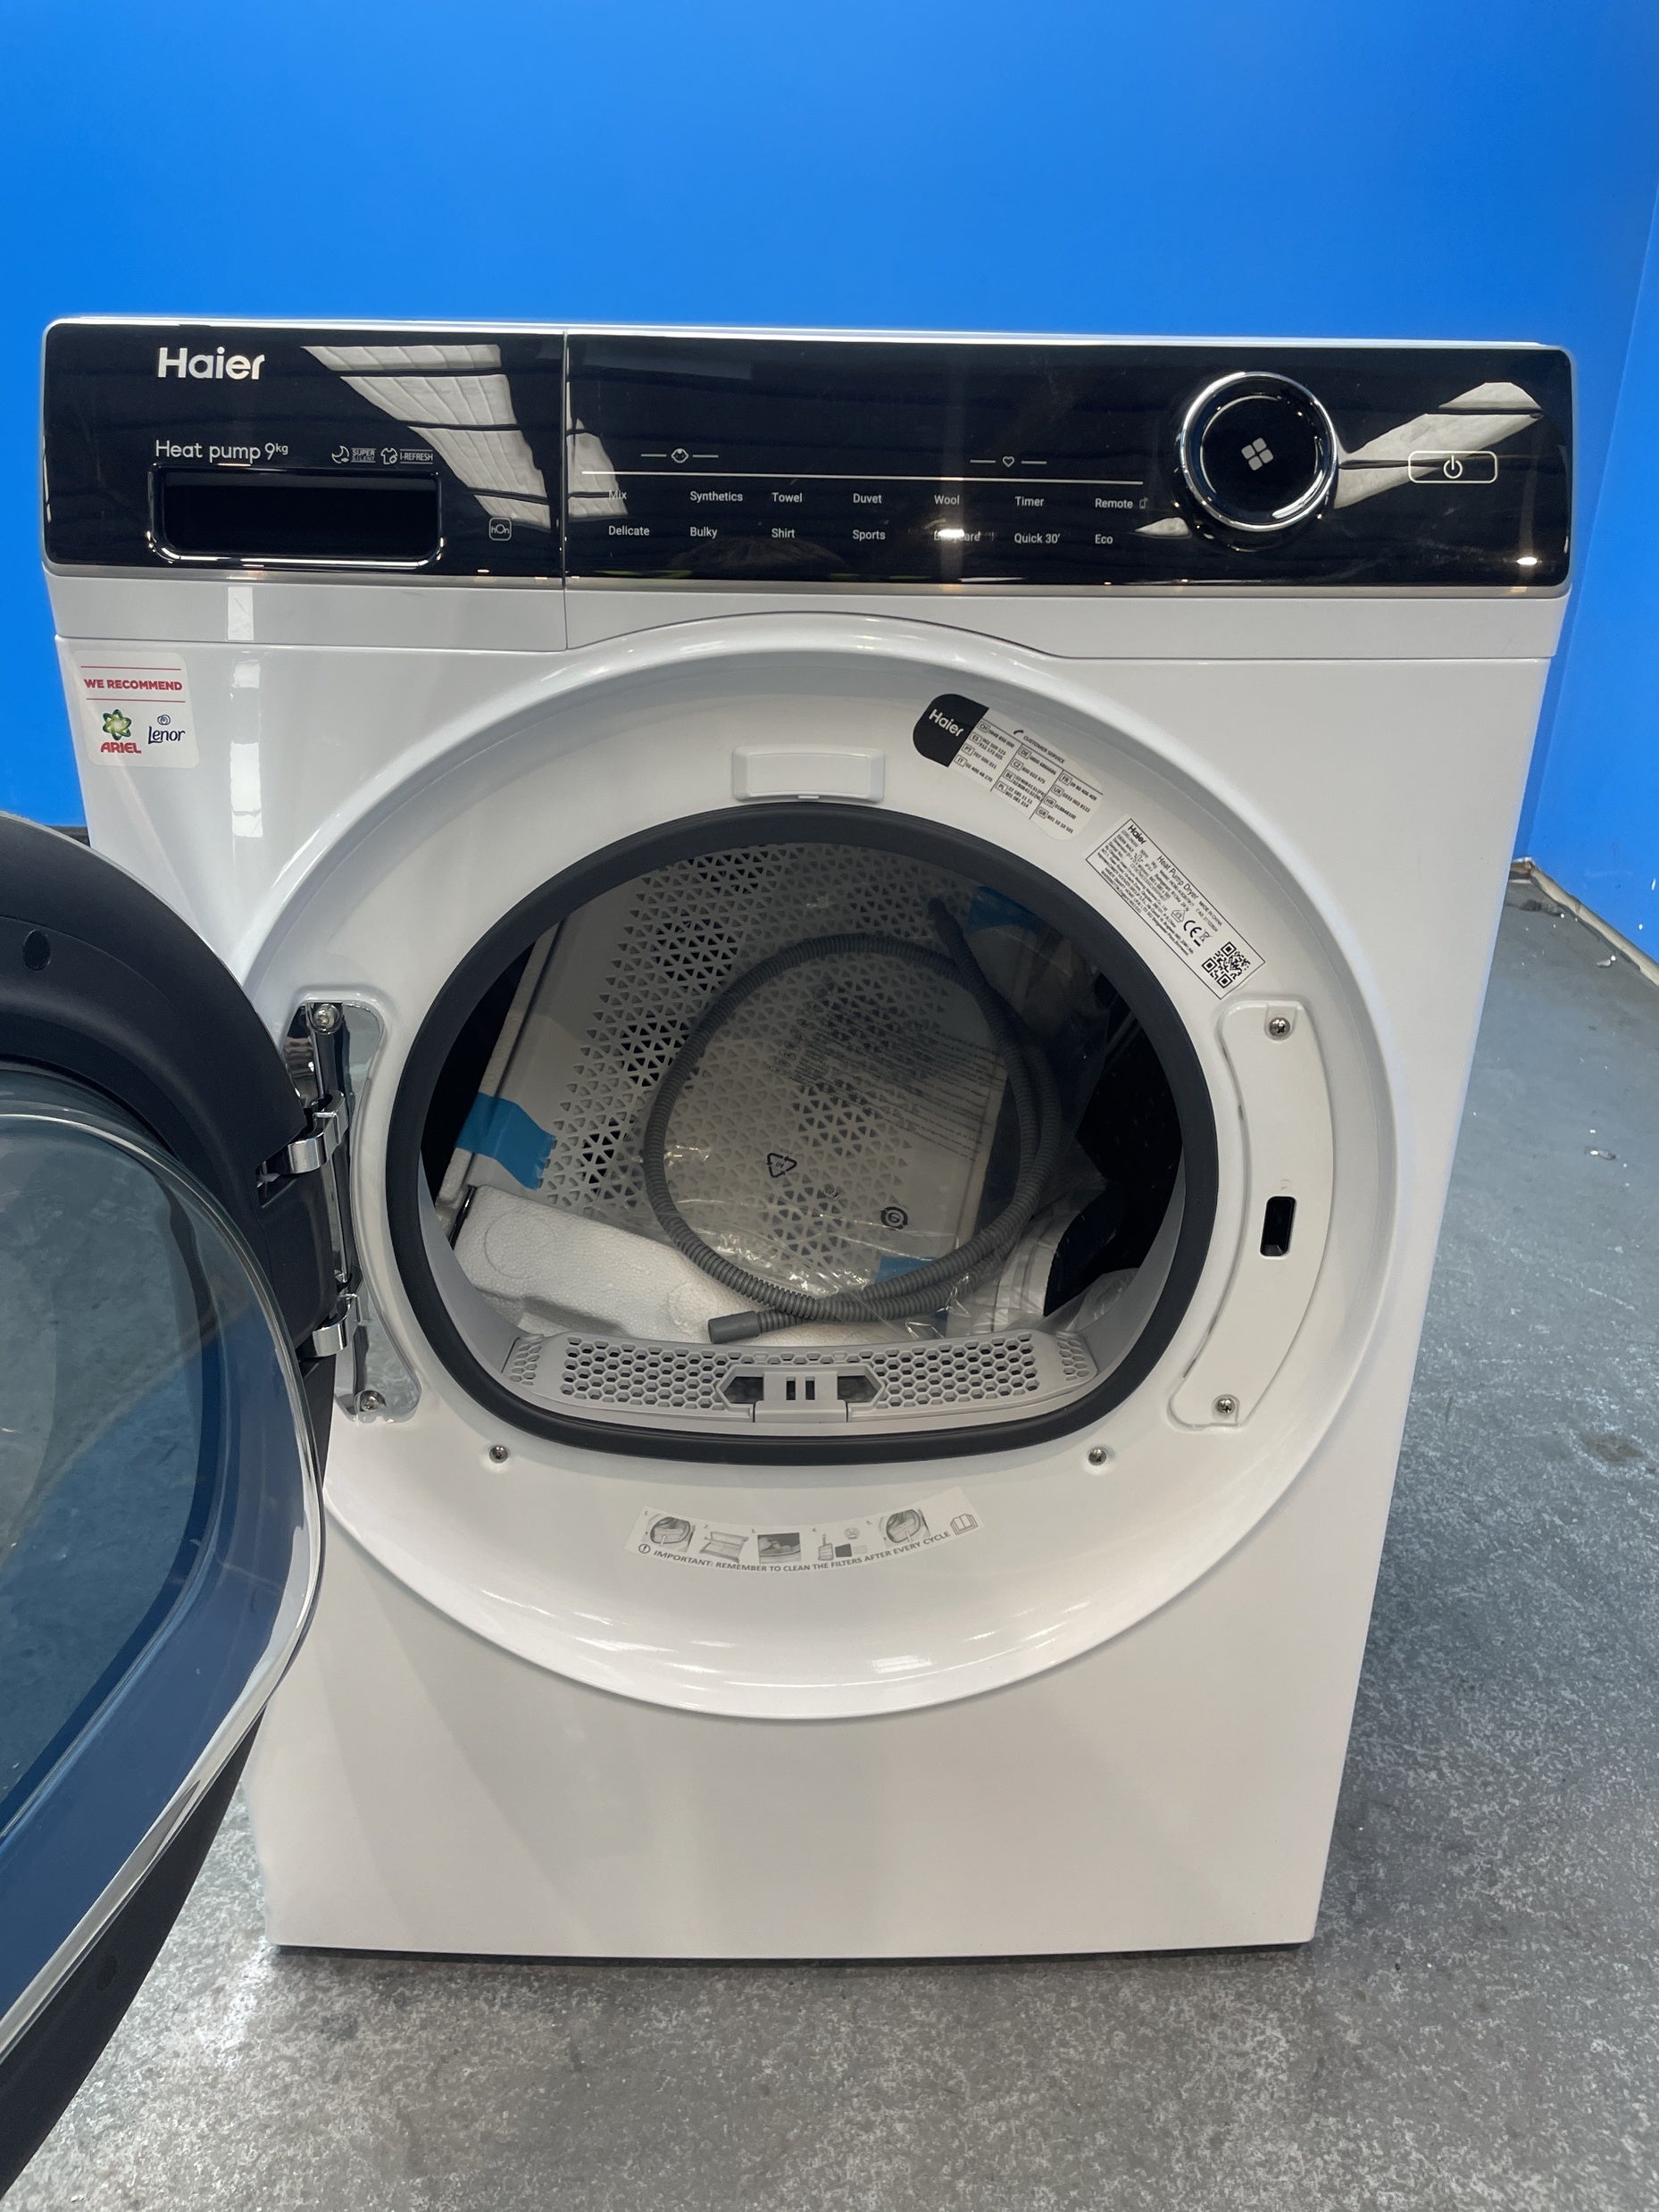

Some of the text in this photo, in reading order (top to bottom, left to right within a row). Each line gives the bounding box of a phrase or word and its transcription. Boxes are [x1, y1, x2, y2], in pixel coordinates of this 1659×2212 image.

[158, 346, 265, 380] Haier
[156, 440, 288, 464] Heat pump 9kg
[400, 452, 434, 461] I-REFRESH
[609, 490, 627, 500] Mix
[690, 491, 743, 503] Synthetics
[772, 492, 803, 502] Towel
[853, 494, 882, 504] Duvet
[934, 495, 960, 505] Wool
[1015, 496, 1045, 507] Timer
[1095, 498, 1134, 509] Remote
[608, 526, 650, 536] Delicate
[690, 527, 717, 539] Bulky
[771, 528, 796, 538] Shirt
[852, 530, 886, 542] Sports
[1014, 533, 1043, 544] Quick
[1095, 534, 1113, 544] Eco
[83, 679, 183, 691] WE RECOMMEND
[929, 709, 964, 736] Haier
[148, 726, 186, 745] Lenor
[100, 742, 142, 754] ARIEL
[1023, 734, 1065, 764] CUSTOMER SERVICE
[1127, 823, 1148, 845] Haier
[1156, 854, 1172, 870] Heat
[1166, 867, 1186, 887] Pump
[1181, 882, 1200, 901] Dryer
[653, 1550, 714, 1568] IMPORTANT:
[715, 1561, 767, 1572] REMEMBER
[783, 1564, 810, 1572] CLEAN
[830, 1557, 863, 1569] FILTERS
[864, 1551, 892, 1562] AFTER
[893, 1542, 921, 1555] EVERY
[923, 1531, 951, 1545] CYCLE
